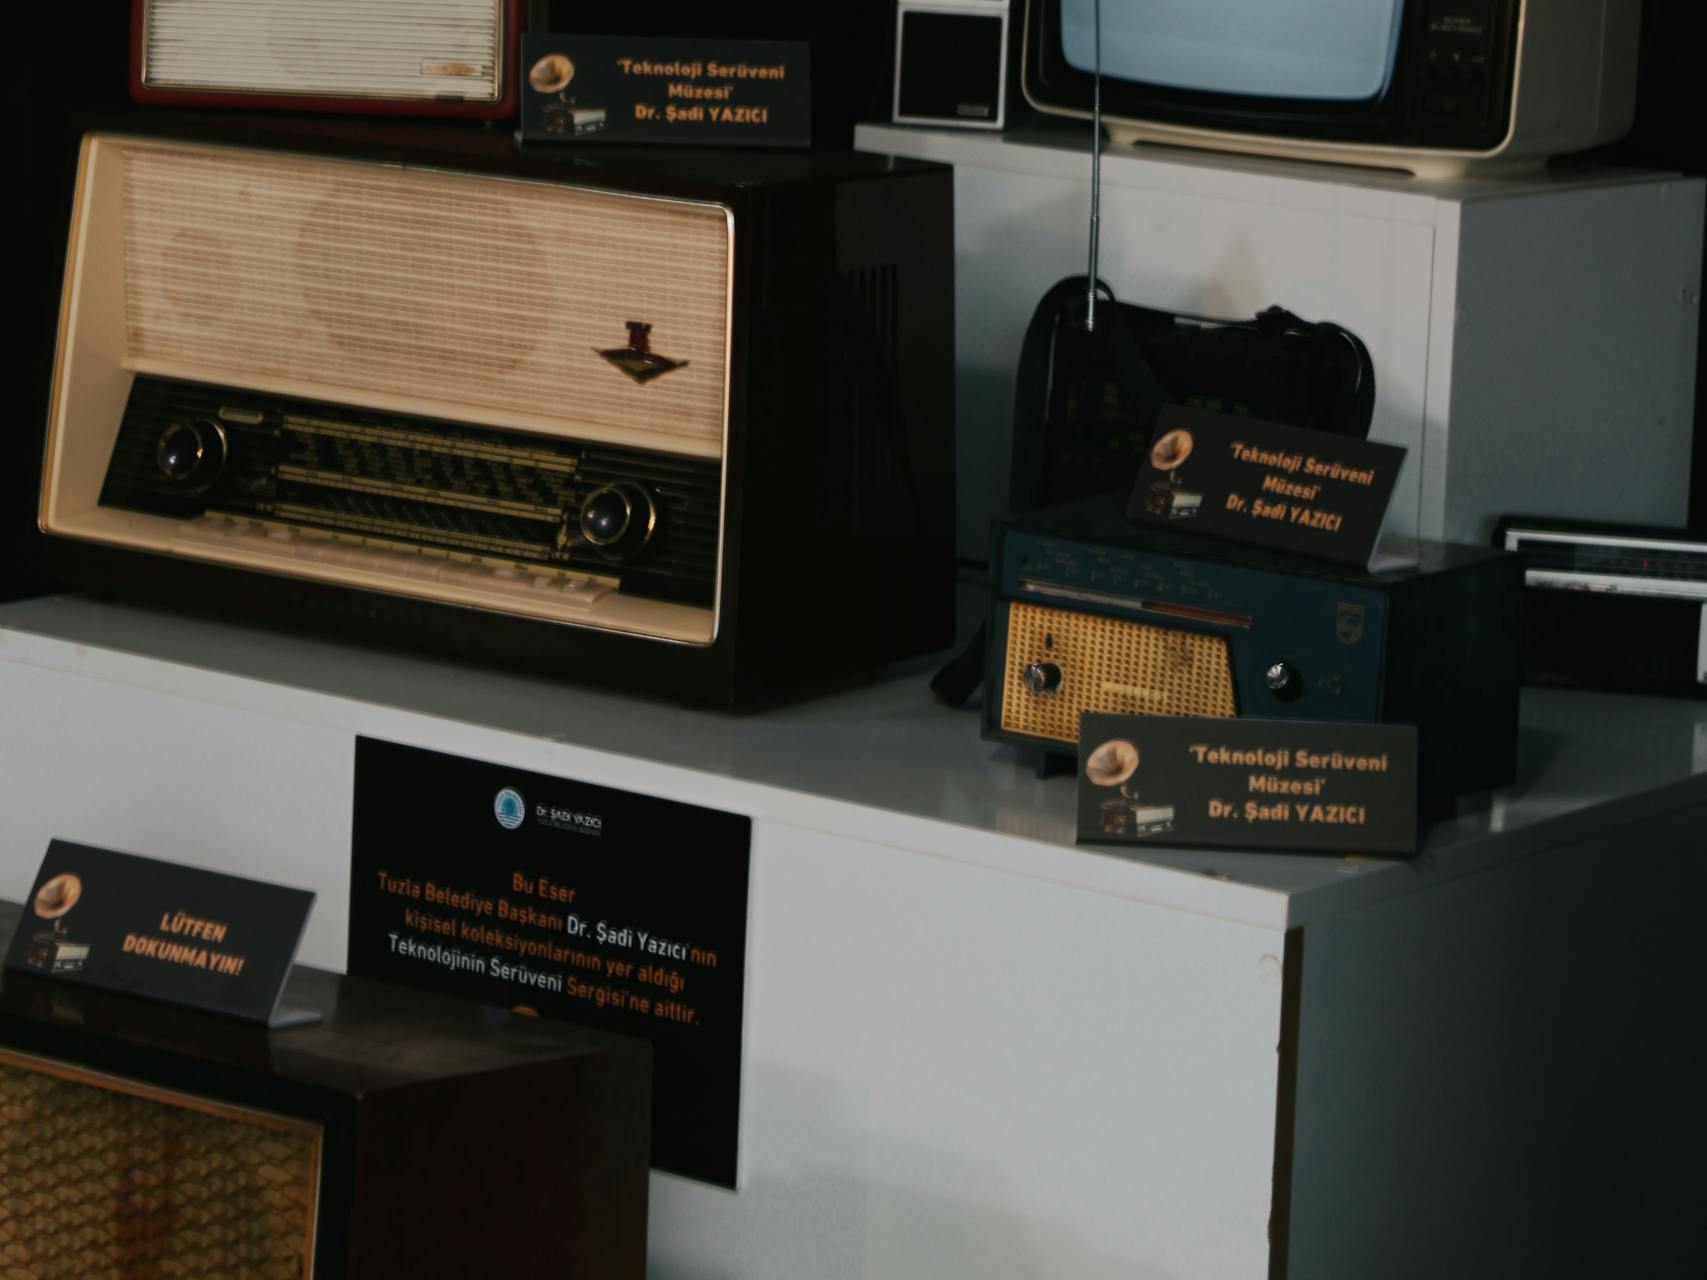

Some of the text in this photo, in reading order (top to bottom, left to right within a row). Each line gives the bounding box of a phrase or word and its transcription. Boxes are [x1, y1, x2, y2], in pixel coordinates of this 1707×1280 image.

[706, 61, 786, 81] Serüveni
[634, 103, 769, 125] Dr. Şadi YAZICI
[1303, 457, 1375, 487] Serüveni
[1225, 493, 1248, 513] Dr.
[1251, 498, 1287, 521] Şadi
[1295, 749, 1389, 773] Serüveni
[1208, 800, 1366, 825] Dr. Şadi YAZICI
[512, 872, 577, 904] Bu Eser
[377, 870, 421, 899] Tuzla
[424, 883, 494, 917] Belediye
[497, 899, 563, 932] Başkanı
[567, 915, 592, 939] Dr.
[596, 922, 633, 949] Şadi
[159, 910, 228, 944] LÜTFEN
[121, 933, 247, 977] DOKUNMAYIN!
[403, 907, 686, 995] kişisel koleksiyonlarının yer aldığı
[388, 932, 702, 1027] Teknolojinin Serüveni Sergisi'ne aittir.
